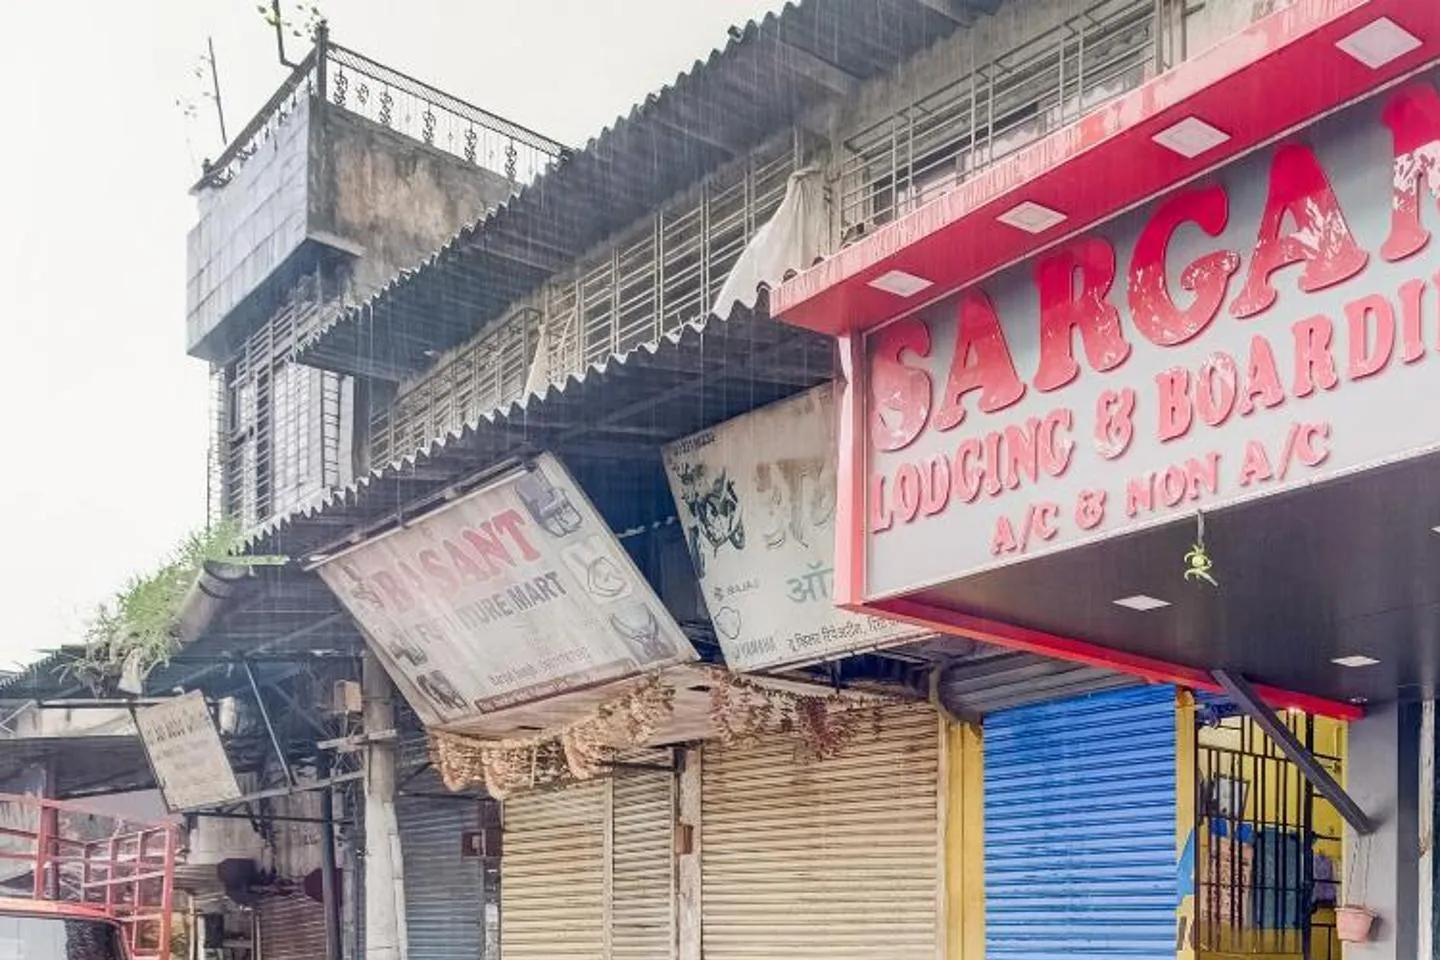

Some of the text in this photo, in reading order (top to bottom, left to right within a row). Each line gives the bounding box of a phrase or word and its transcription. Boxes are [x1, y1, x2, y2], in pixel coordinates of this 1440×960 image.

[1094, 386, 1136, 462] &
[991, 420, 1332, 556] A/C & NON A/C
[509, 570, 568, 612] MART
